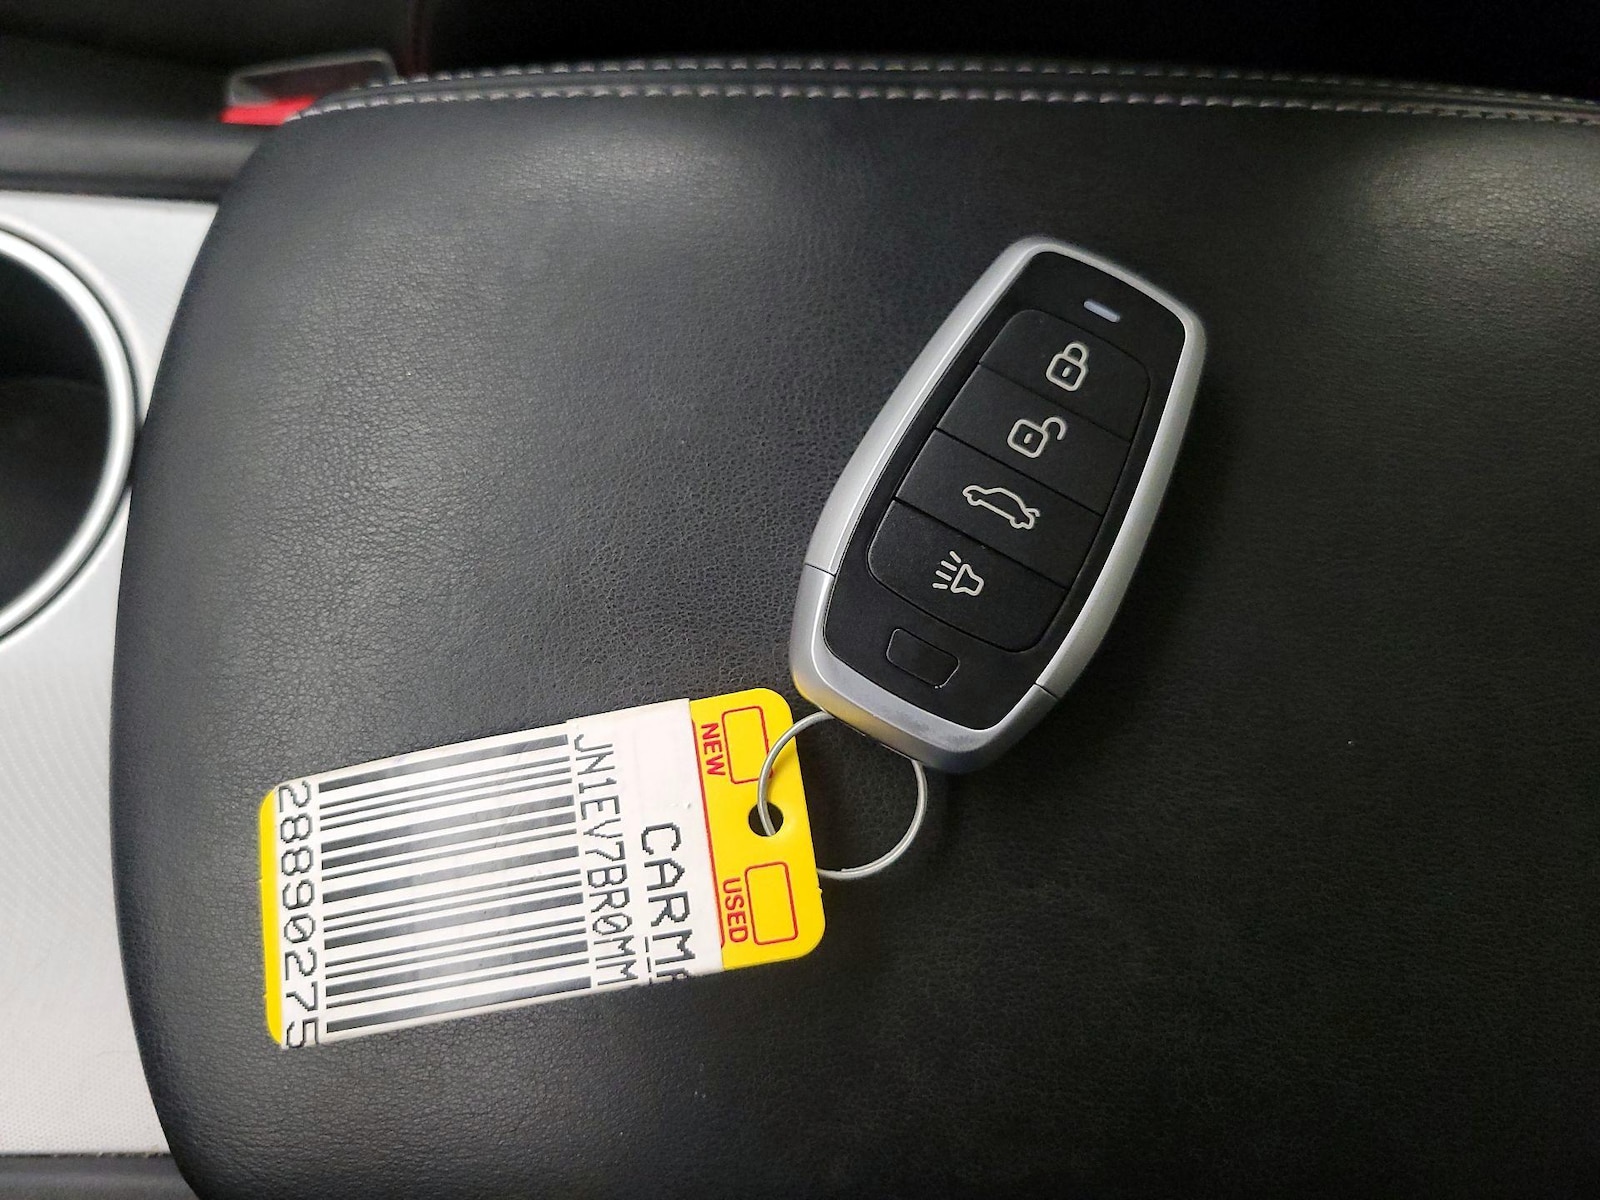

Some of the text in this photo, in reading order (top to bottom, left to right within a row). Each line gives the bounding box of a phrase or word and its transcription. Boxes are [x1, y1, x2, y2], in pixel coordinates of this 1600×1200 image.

[701, 723, 726, 776] NEW
[278, 780, 319, 1048] 28890275
[574, 735, 639, 986] JN1EV7BR0MM
[722, 879, 748, 943] USED
